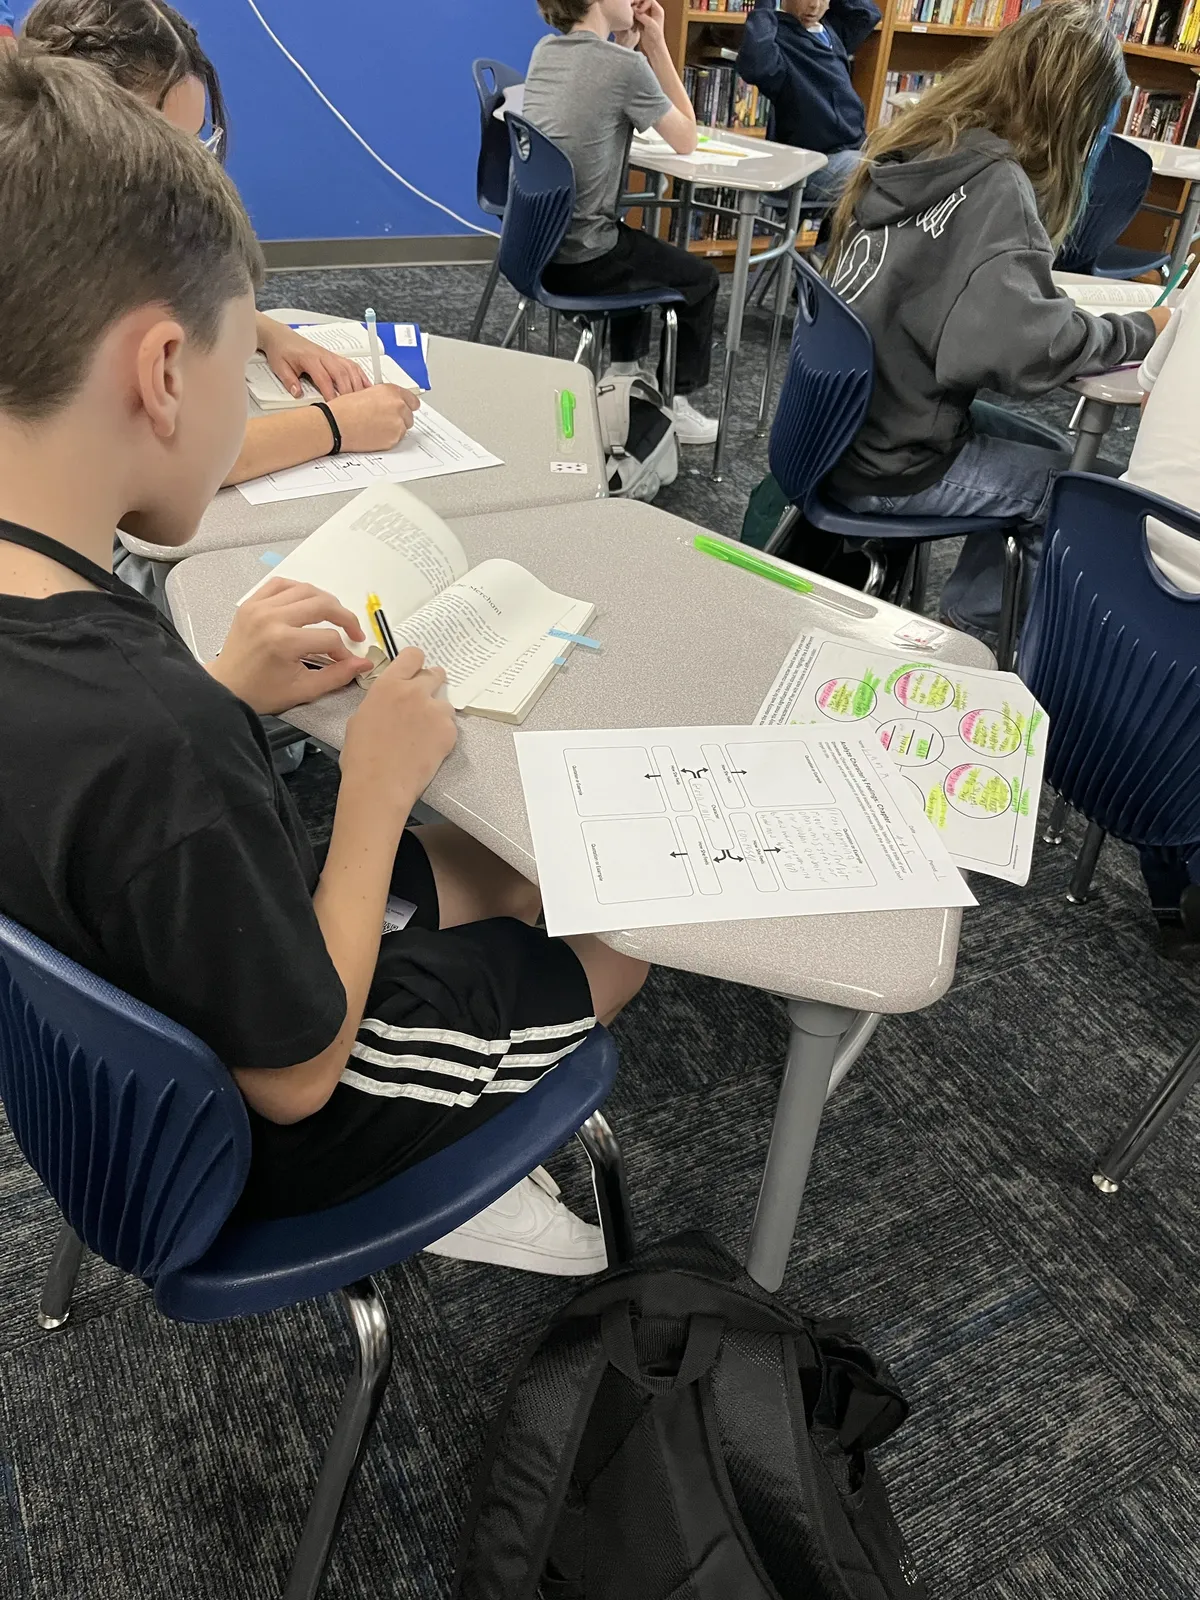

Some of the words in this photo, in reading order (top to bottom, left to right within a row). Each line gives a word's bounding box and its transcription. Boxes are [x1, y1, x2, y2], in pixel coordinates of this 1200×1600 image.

[805, 755, 814, 769] Quotation
[813, 771, 822, 784] Example
[840, 741, 853, 757] Analyze
[850, 758, 867, 782] Character's
[864, 782, 879, 803] Feelings:
[877, 804, 891, 823] Chapter
[711, 804, 720, 819] Character
[840, 757, 850, 770] Character
[882, 831, 892, 844] Identify
[892, 852, 900, 861] traits
[899, 865, 907, 874] your
[843, 828, 854, 845] Quotation
[853, 849, 863, 864] Example
[856, 796, 866, 811] examples
[866, 815, 874, 825] those
[880, 844, 889, 854] areas
[895, 871, 904, 881] Don't
[928, 859, 938, 872] Period
